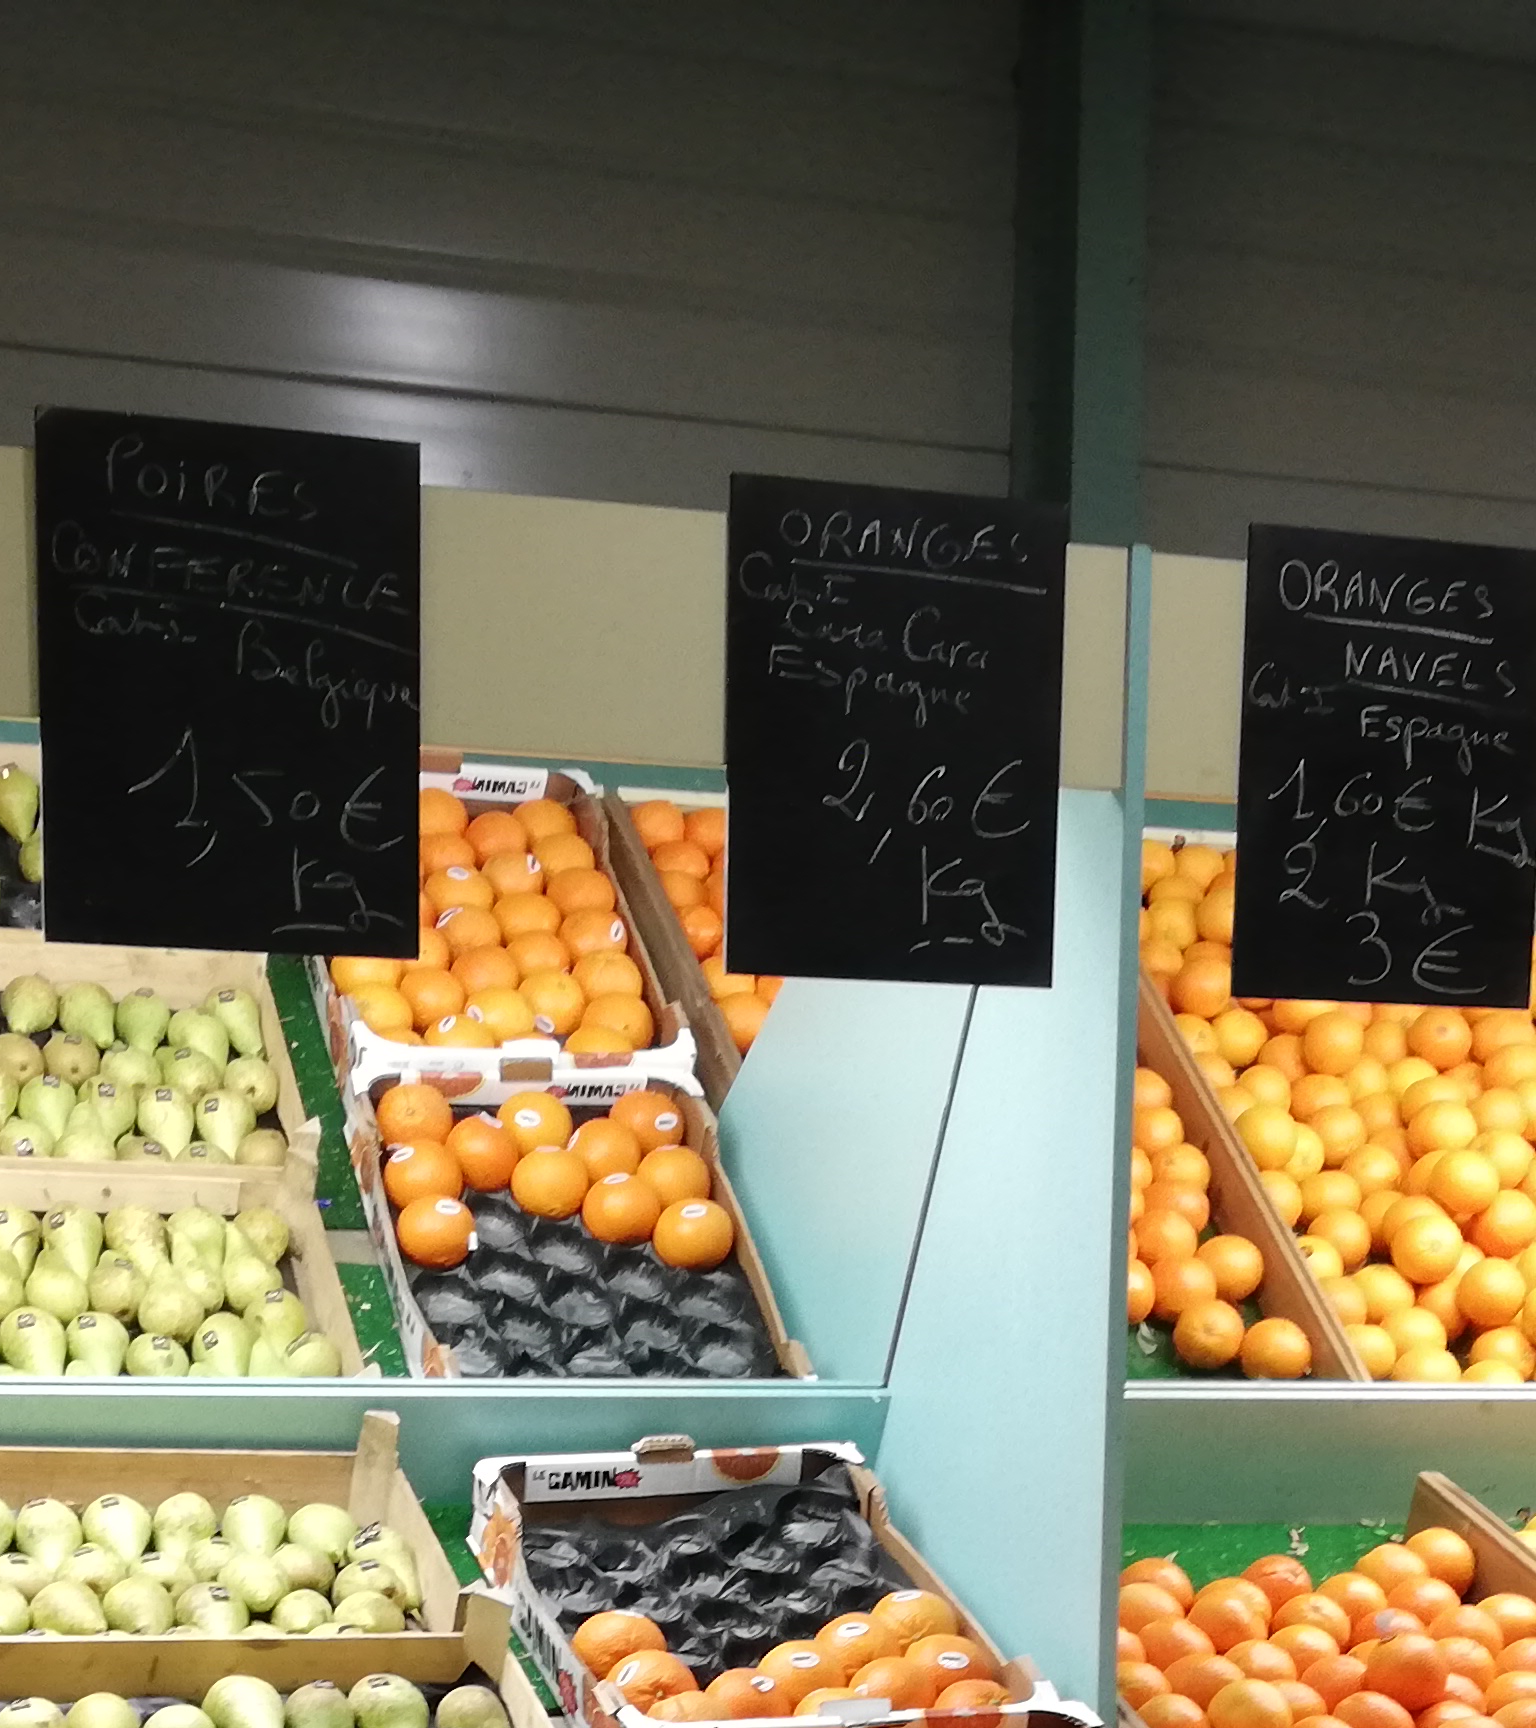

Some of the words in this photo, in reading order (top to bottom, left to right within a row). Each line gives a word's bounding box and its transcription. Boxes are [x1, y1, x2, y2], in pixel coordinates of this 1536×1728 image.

[778, 507, 1029, 570] ORANGES
[1278, 557, 1495, 619] ORANGES
[1344, 640, 1517, 698] NAVELS
[1359, 704, 1517, 776] Espagne
[548, 1467, 617, 1491] GAMIN
